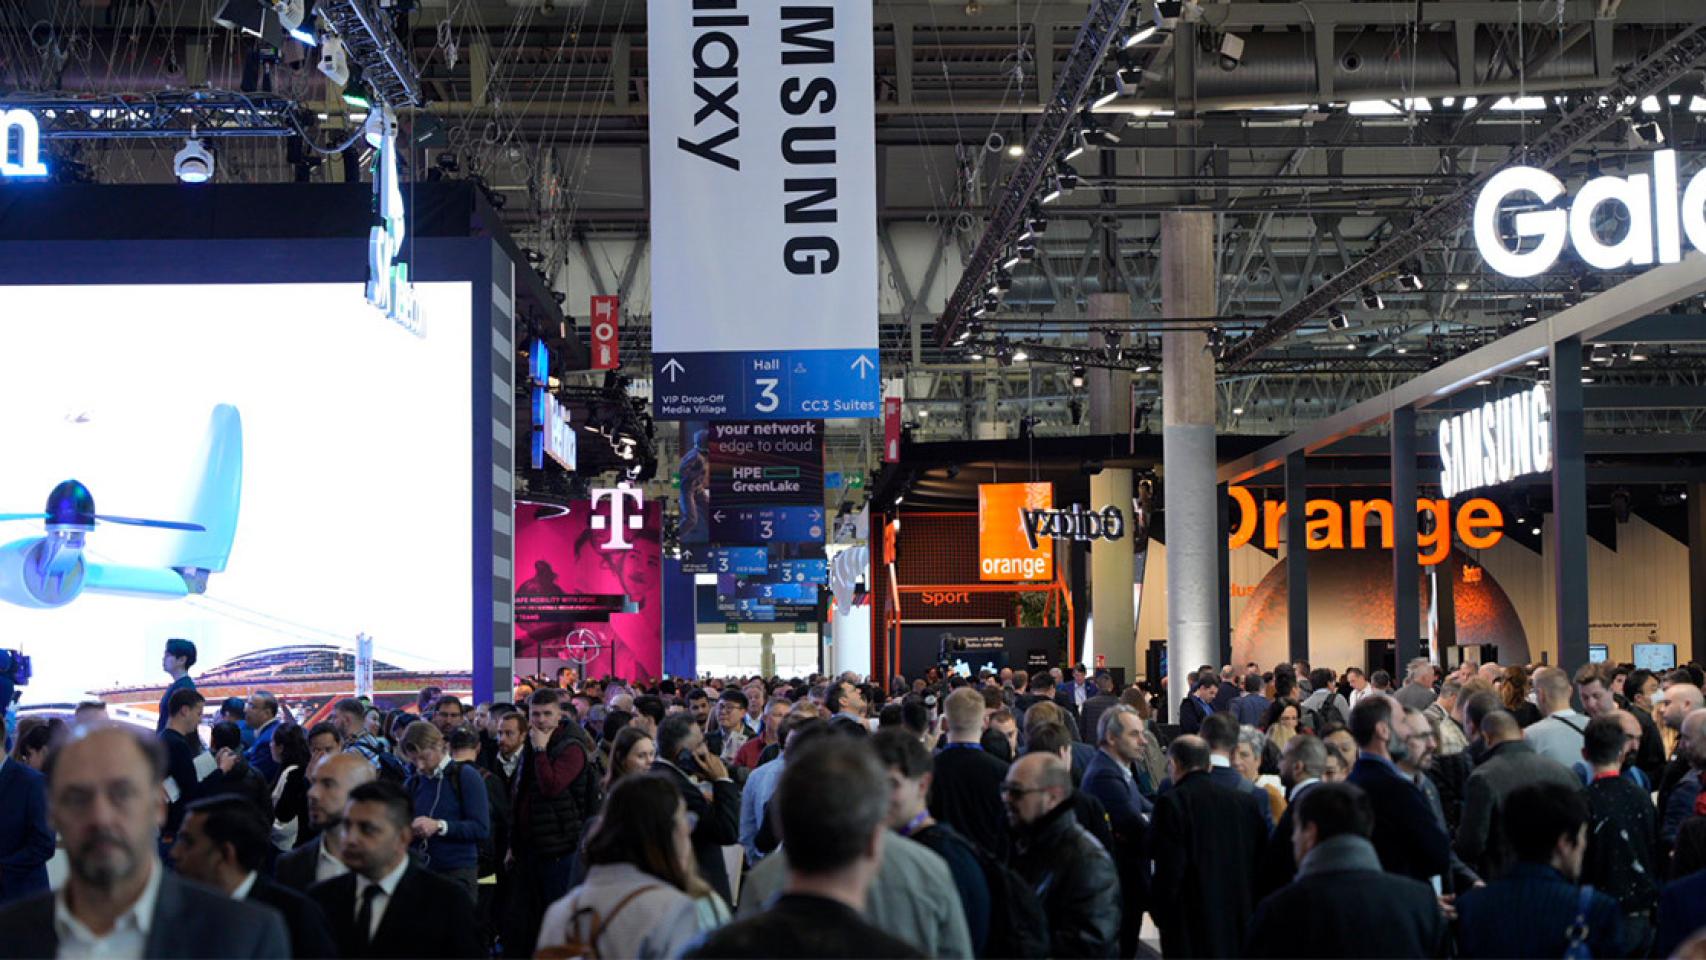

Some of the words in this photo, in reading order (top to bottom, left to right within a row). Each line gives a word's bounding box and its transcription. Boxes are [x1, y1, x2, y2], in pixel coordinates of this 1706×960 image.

[780, 6, 840, 275] MSUNG
[754, 359, 779, 370] Hall
[662, 396, 679, 404] VIP
[682, 395, 724, 405] Drop-Off
[755, 378, 779, 412] 3
[662, 405, 690, 413] Media
[693, 405, 727, 415] Village
[801, 400, 829, 411] CC3
[834, 399, 875, 411] Suites
[716, 424, 749, 438] your
[753, 421, 816, 435] network
[719, 440, 753, 455] edge
[758, 441, 771, 452] to
[775, 438, 813, 452] cloud
[1438, 384, 1550, 499] SAMSUNG
[732, 467, 762, 479] HPE
[732, 481, 800, 493] GreenLake
[760, 520, 773, 539] 3
[719, 557, 729, 572] 3
[782, 569, 792, 582] 3
[921, 591, 971, 606] Sport
